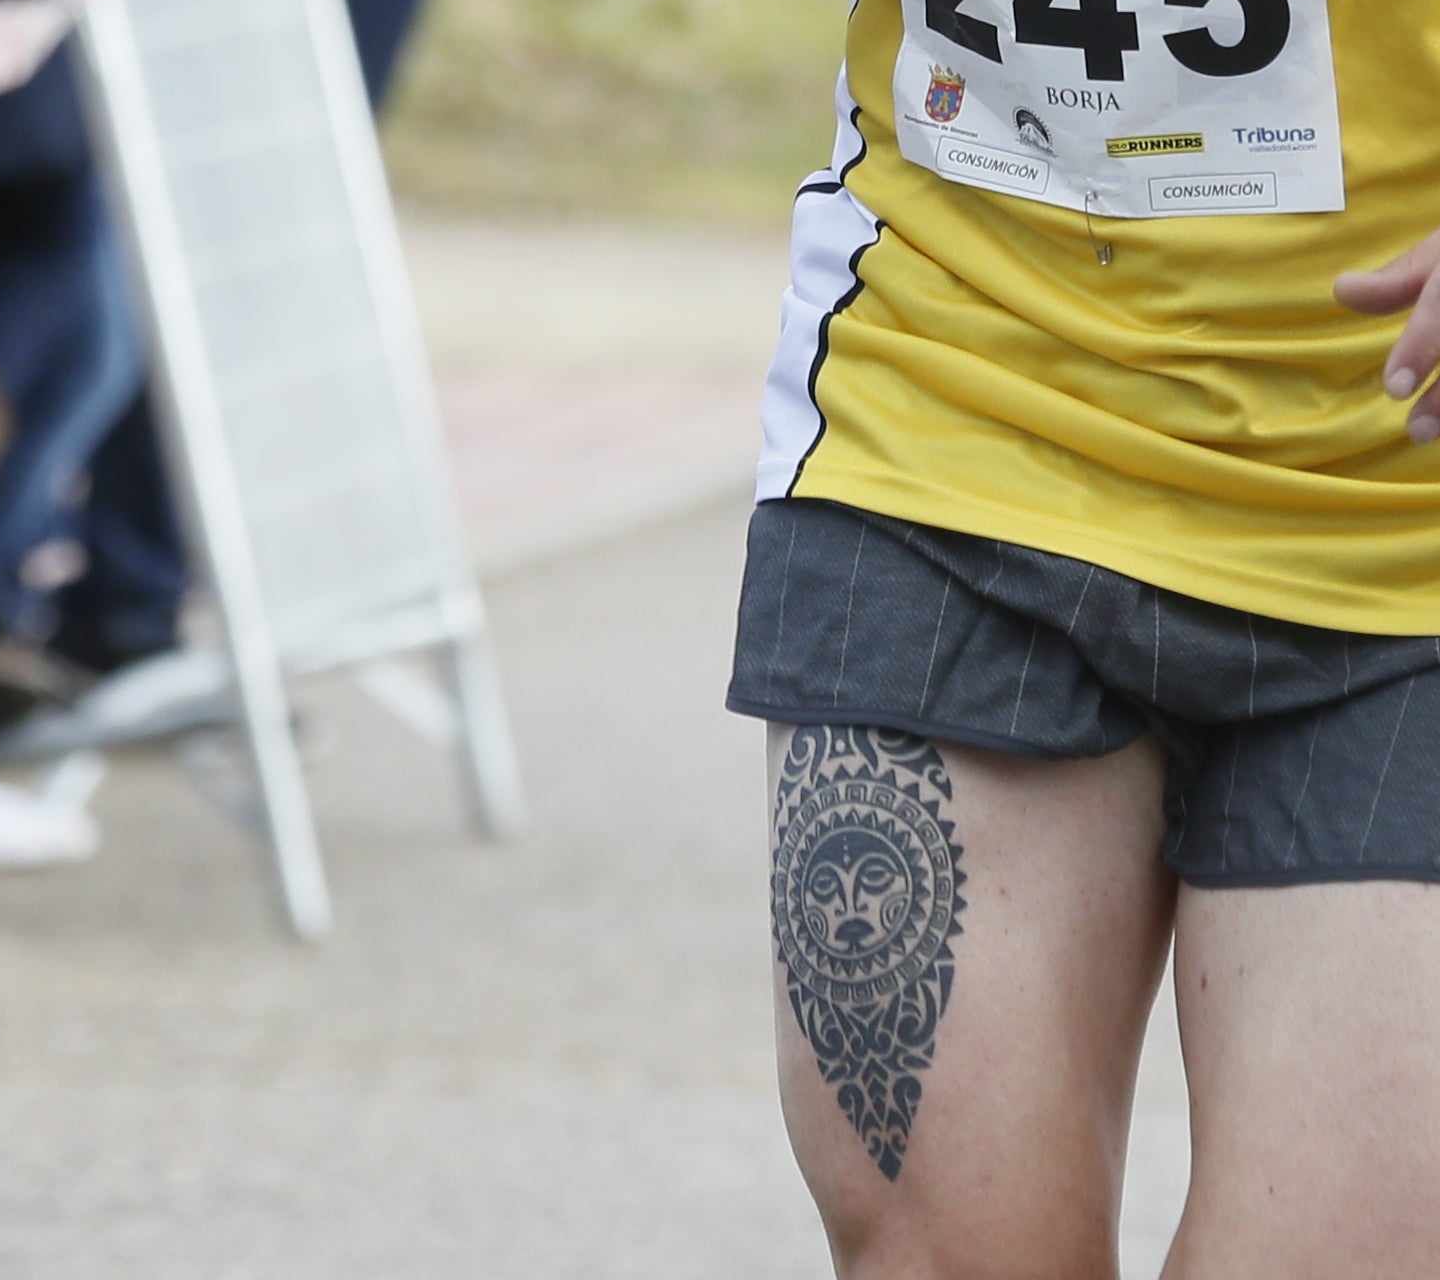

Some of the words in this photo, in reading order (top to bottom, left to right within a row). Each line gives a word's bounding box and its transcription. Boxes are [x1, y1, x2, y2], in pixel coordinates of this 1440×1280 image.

[1046, 86, 1122, 116] BORJA
[1231, 127, 1317, 144] Tribuna
[948, 149, 1040, 181] CONSUMICIÓN
[1163, 181, 1265, 200] CONSUMICIÓN
